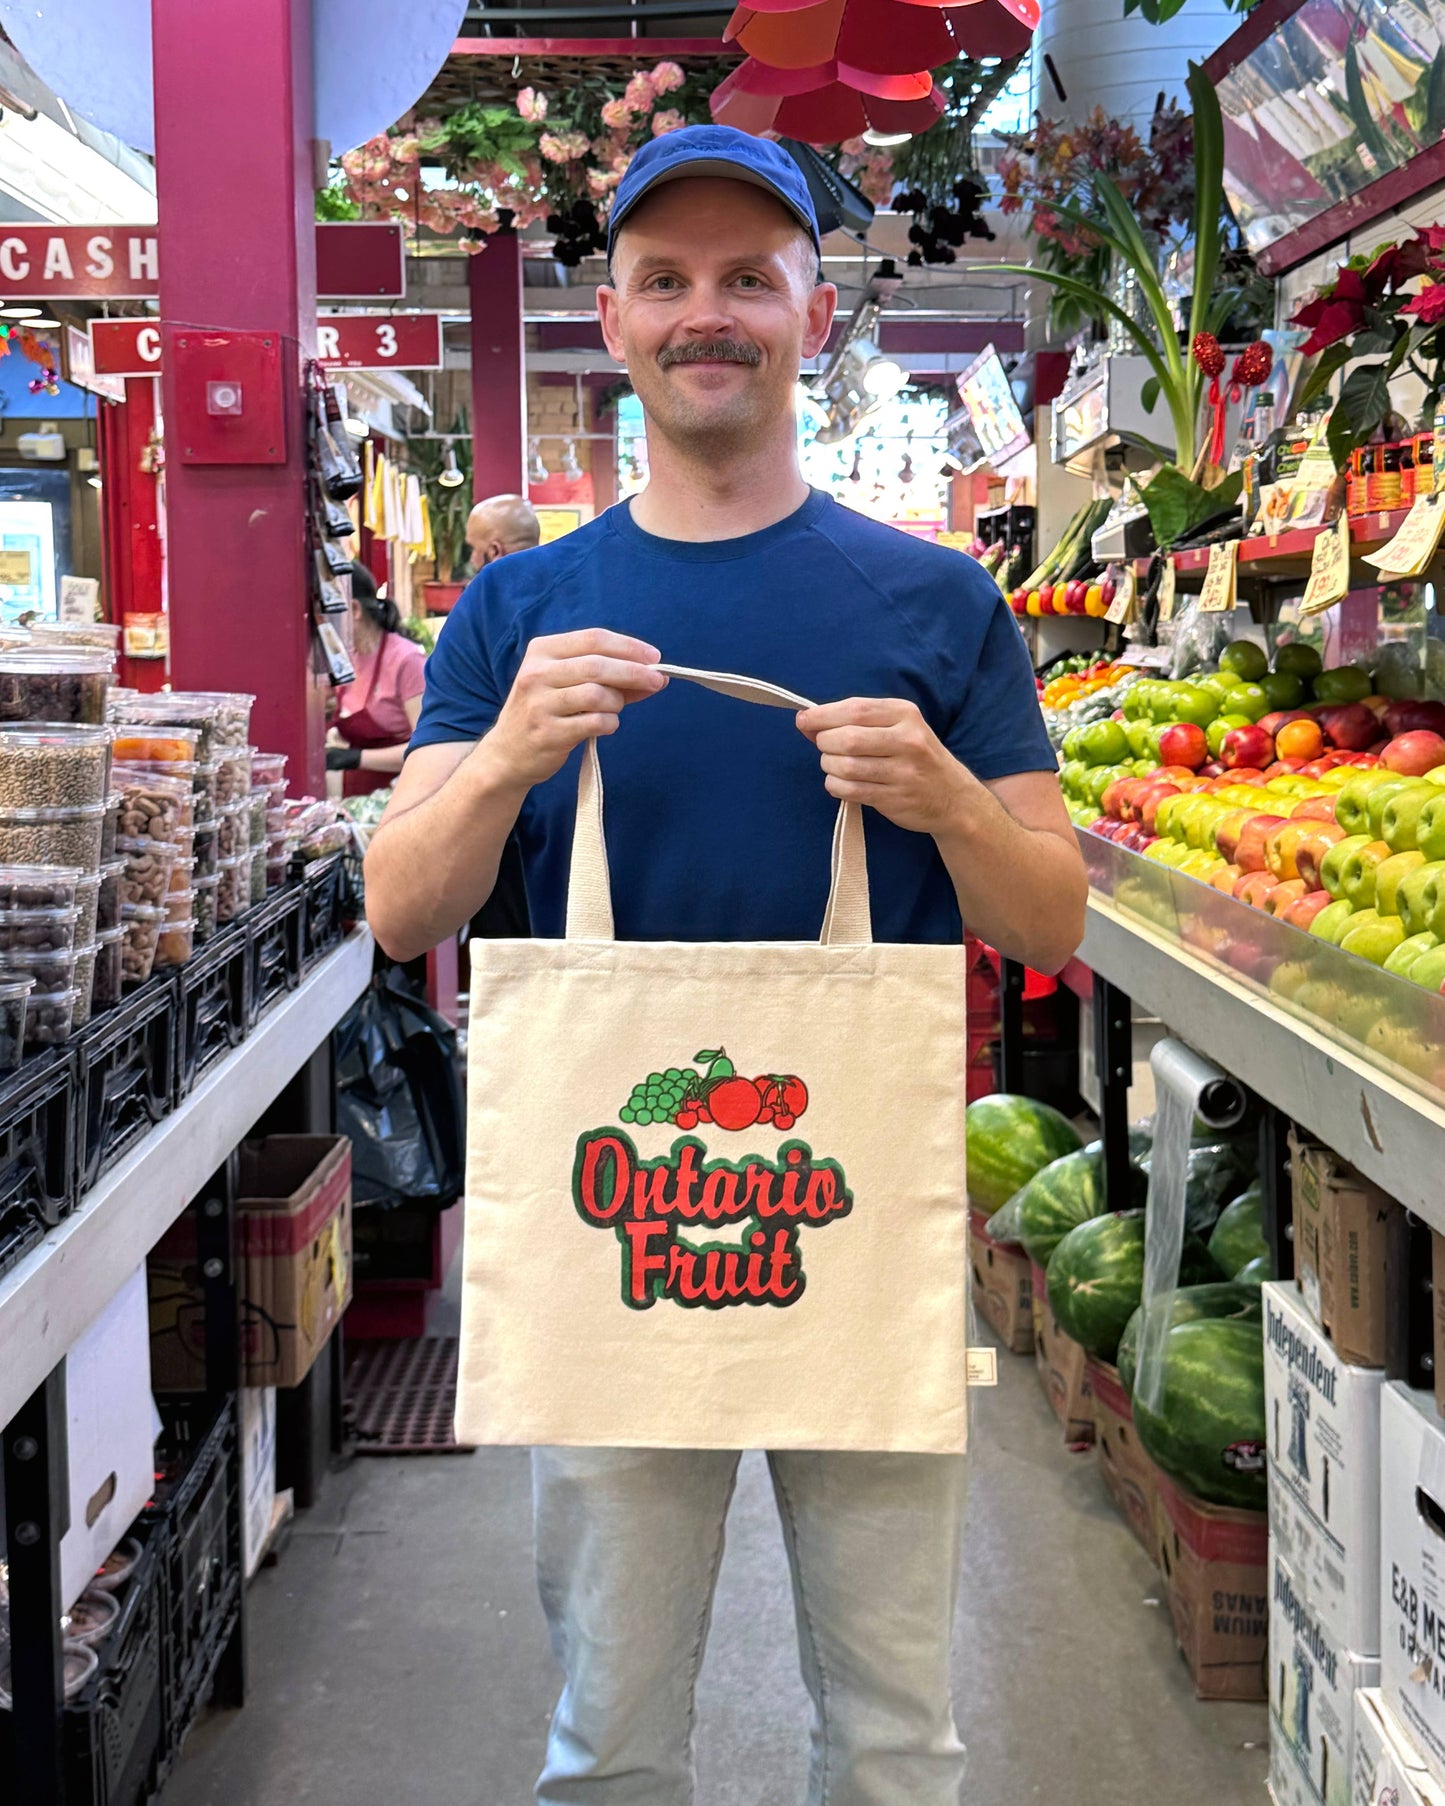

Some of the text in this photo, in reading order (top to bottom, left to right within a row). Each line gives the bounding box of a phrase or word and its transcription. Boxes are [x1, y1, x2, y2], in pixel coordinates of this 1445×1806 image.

[0, 236, 160, 281] CASH
[375, 323, 398, 358] 3
[578, 1133, 847, 1221] Ontario
[621, 1219, 800, 1303] Fruit
[1266, 1298, 1338, 1407] Independent
[1391, 1561, 1418, 1627] E&B
